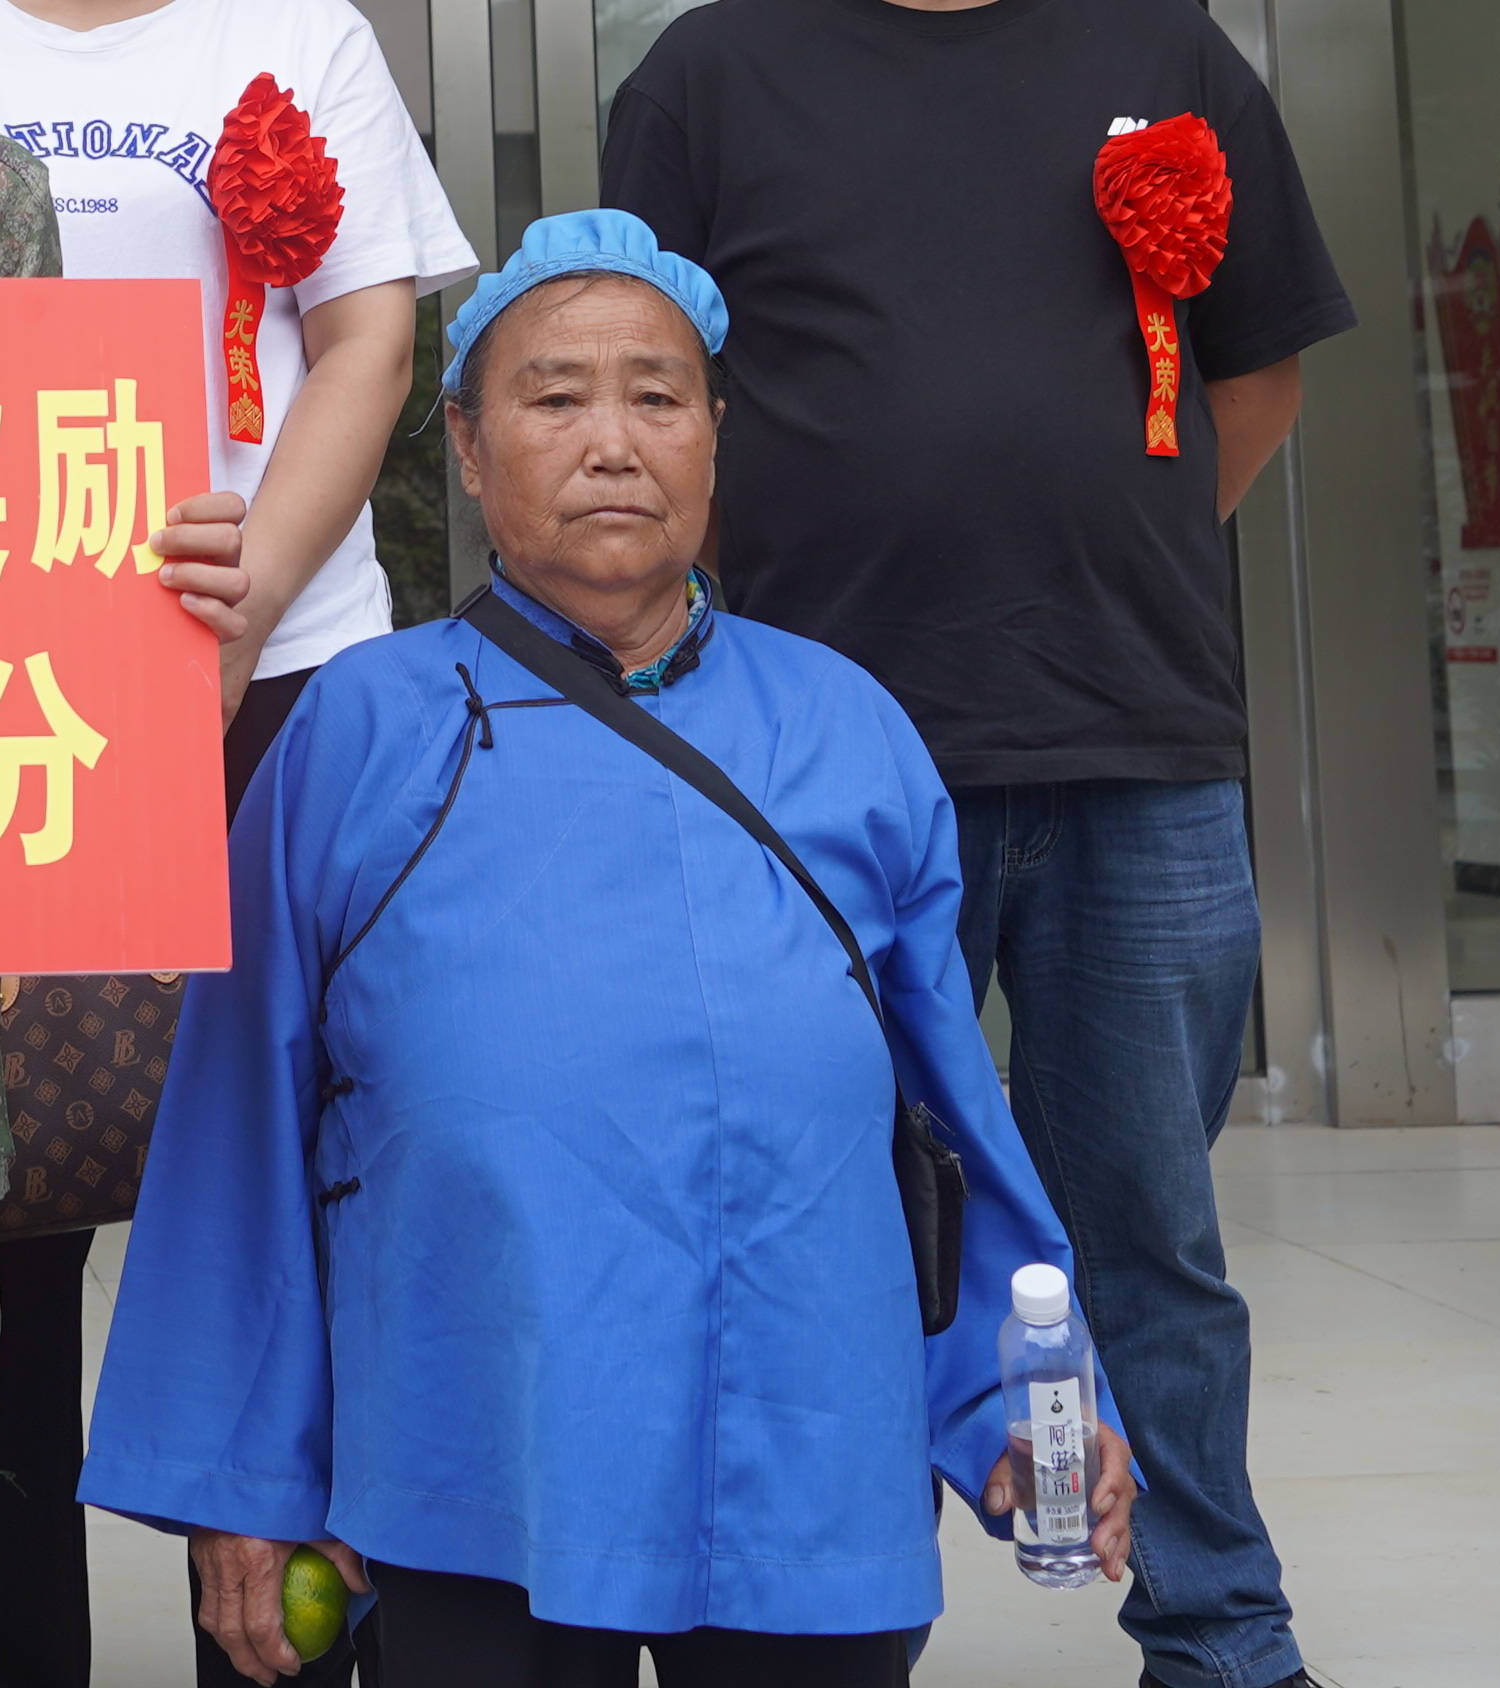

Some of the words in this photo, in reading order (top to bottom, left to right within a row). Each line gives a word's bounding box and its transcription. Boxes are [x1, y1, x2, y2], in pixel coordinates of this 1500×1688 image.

[4, 118, 219, 218] TIONA
[53, 198, 119, 214] SC.1988
[225, 298, 260, 390] 光荣
[1147, 311, 1178, 403] 光荣
